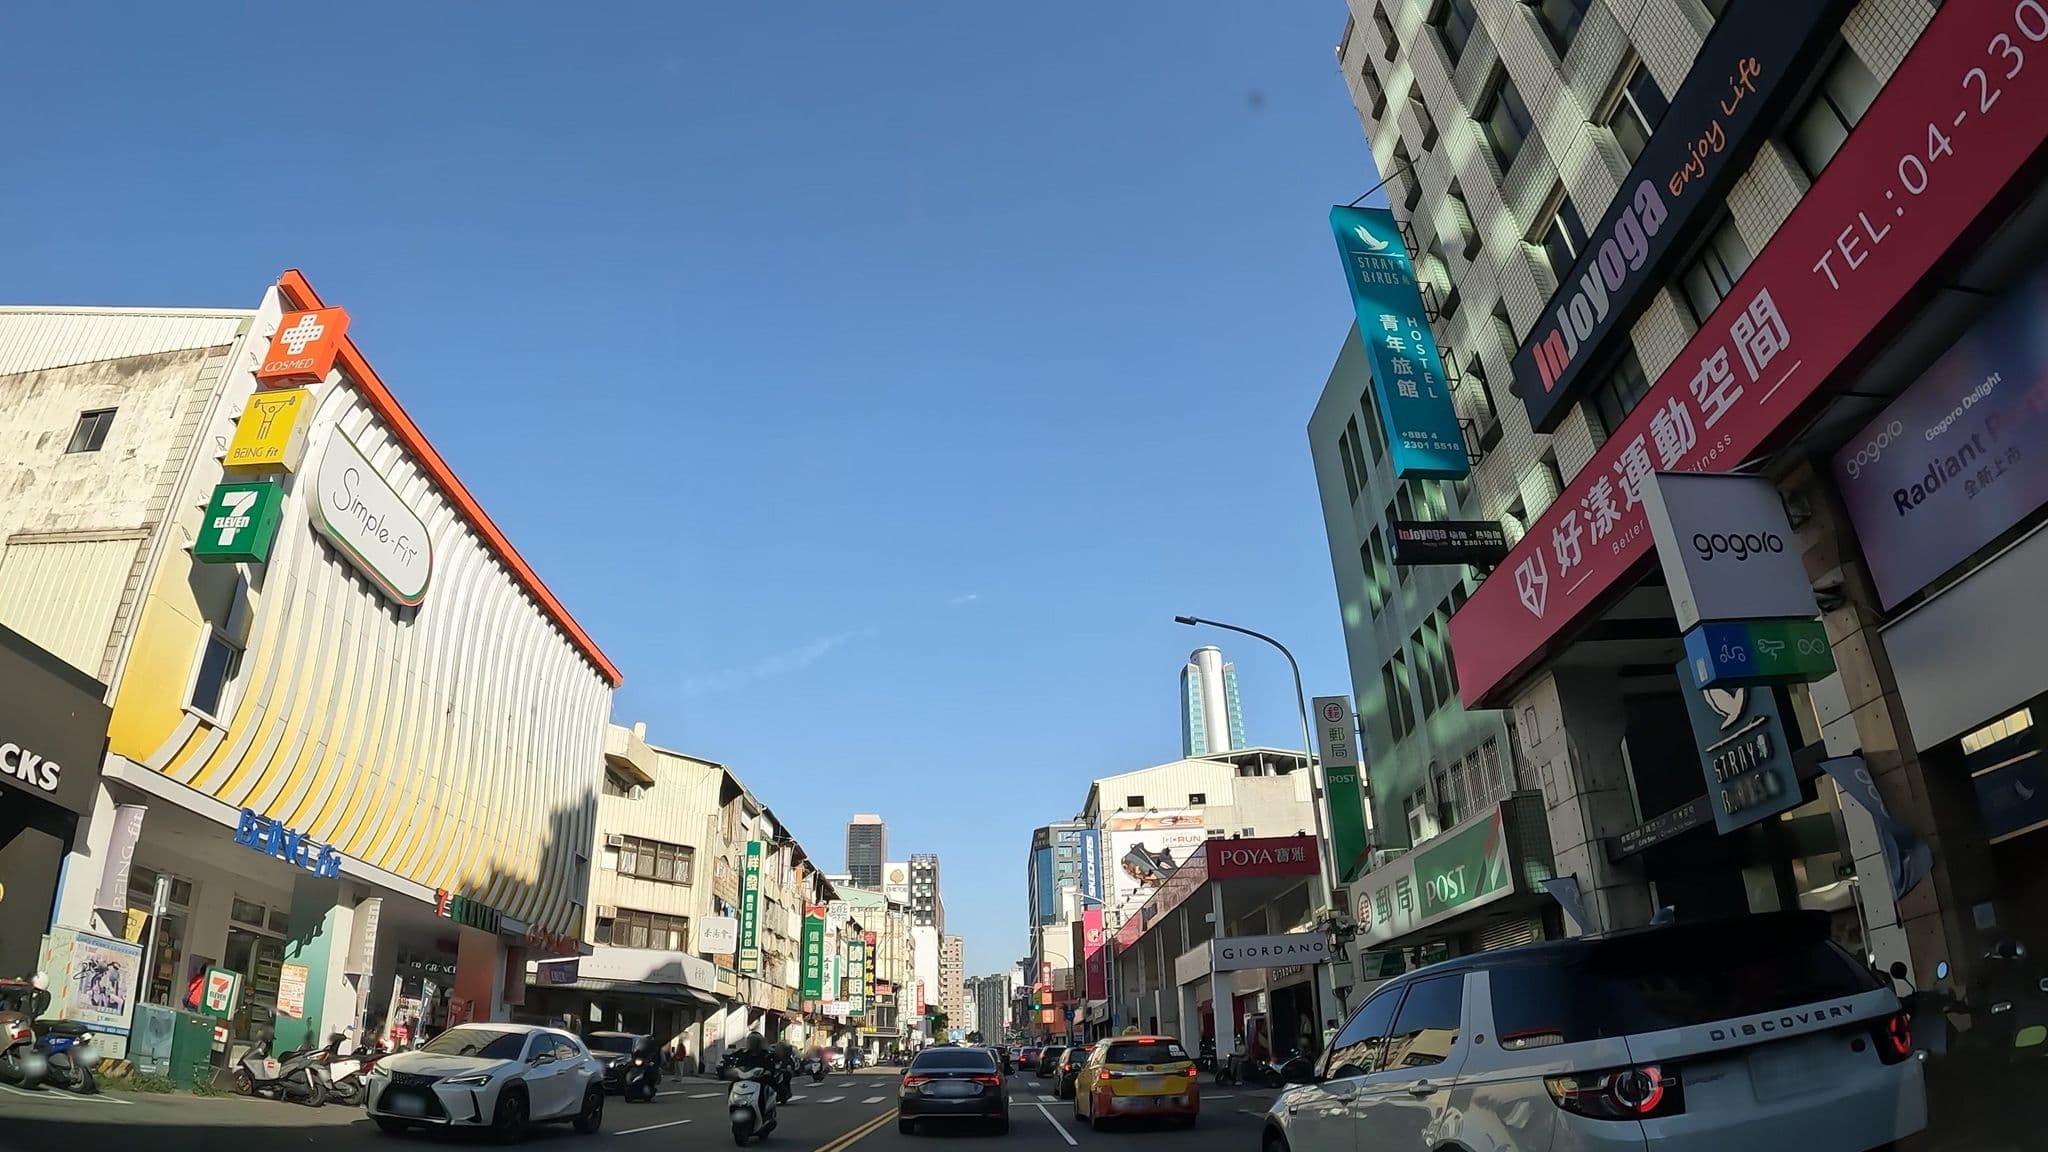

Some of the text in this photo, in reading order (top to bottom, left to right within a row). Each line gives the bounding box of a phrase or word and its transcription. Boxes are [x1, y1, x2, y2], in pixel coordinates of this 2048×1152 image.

[1668, 56, 1762, 196] Enjoy Life
[1358, 257, 1395, 271] STRAY
[1362, 271, 1400, 285] BIRDS
[1532, 178, 1669, 394] InJoyoga
[264, 358, 314, 373] COSMED
[1378, 313, 1420, 400] 青年旅館
[1406, 316, 1438, 399] HOSTEL
[1923, 405, 1963, 443] Gogoro
[1961, 371, 2003, 412] Delight
[265, 446, 279, 457] fit
[1403, 440, 1430, 450] 2301
[1430, 432, 1438, 440] 4
[1551, 287, 1791, 578] 好漾運動空間
[1846, 418, 1904, 480] gogoro
[1891, 431, 1987, 518] Radiant
[1962, 444, 2022, 499] 全新上市
[1611, 434, 1732, 555] Better itness
[217, 490, 258, 546] 7
[1692, 530, 1784, 562] gogoro
[1328, 726, 1348, 760] 郵局
[1713, 742, 1757, 784] STRAY
[0, 742, 61, 791] CKS
[1328, 773, 1355, 785] POST
[127, 812, 143, 837] fit
[1219, 846, 1306, 867] POYA 寶雅
[1375, 875, 1415, 925] 郵局
[1425, 864, 1466, 910] POST
[1222, 942, 1324, 960] GIORDANO
[1709, 1004, 1853, 1042] DISCOVERY
